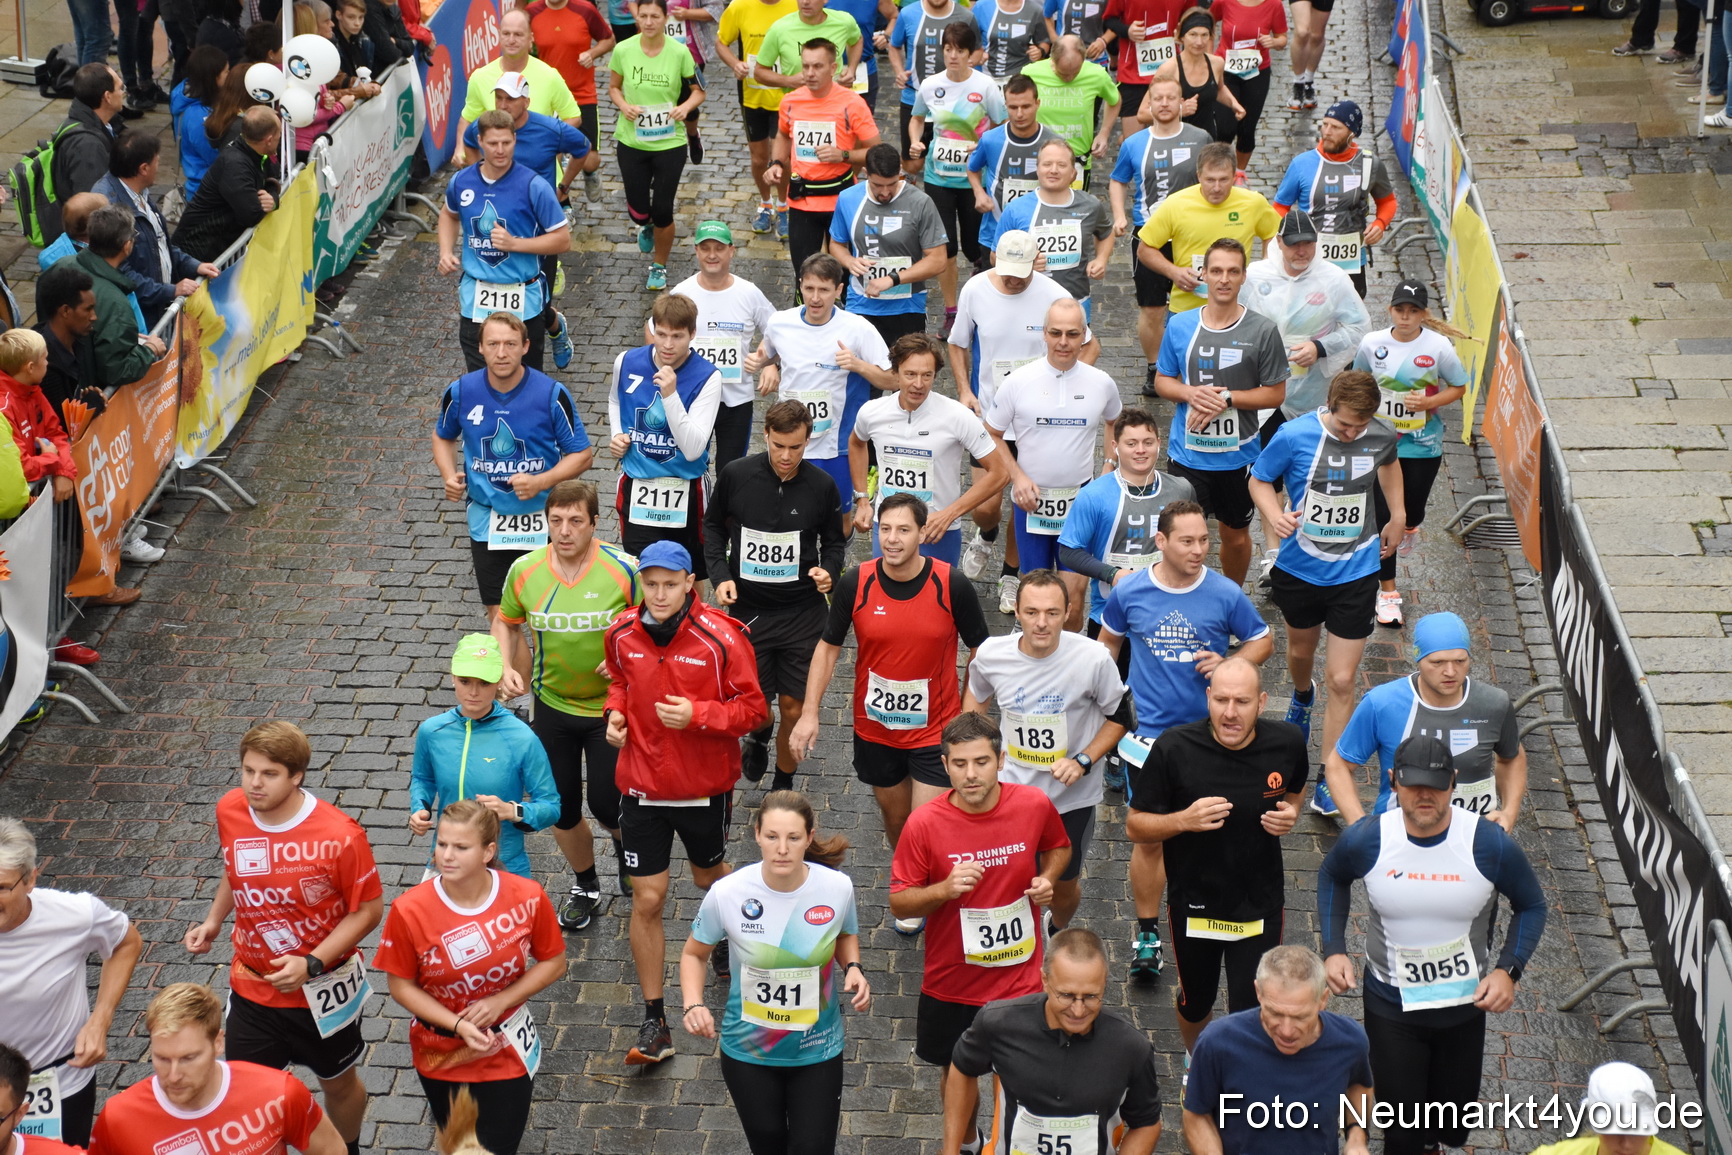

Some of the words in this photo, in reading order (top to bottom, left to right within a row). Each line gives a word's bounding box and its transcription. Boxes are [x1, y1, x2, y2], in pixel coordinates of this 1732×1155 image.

[464, 10, 499, 74] Hervis
[1140, 45, 1173, 63] 2018
[1229, 57, 1259, 71] 2373
[426, 64, 451, 132] Hervis
[1040, 87, 1083, 96] NOVINA
[1040, 98, 1083, 108] HOTELS
[637, 112, 670, 127] 2147
[797, 131, 832, 147] 2474
[937, 147, 970, 163] 2467
[460, 188, 475, 207] 9
[1036, 235, 1077, 253] 2252
[1321, 243, 1358, 259] 3039
[1047, 256, 1068, 264] Daniel
[479, 289, 520, 310] 2118
[625, 373, 644, 394] 7
[466, 404, 484, 426] 4
[1195, 438, 1228, 447] Christian
[474, 459, 544, 474] FIBALON
[884, 467, 927, 489] 2631
[637, 486, 684, 508] 2117
[645, 510, 671, 522] Jürgen
[1310, 504, 1360, 525] 2138
[495, 514, 544, 532] 2495
[501, 536, 536, 544] Christian
[1319, 528, 1346, 536] Tobias
[746, 541, 795, 564] 2884
[753, 566, 786, 576] Andreas
[529, 609, 614, 632] BOCK
[870, 687, 923, 712] 2882
[878, 713, 911, 724] Thomas
[1014, 726, 1055, 750] 183
[1017, 750, 1055, 764] Bernhard
[236, 841, 267, 850] raumbox
[976, 842, 1026, 860] RUNNERS
[624, 850, 639, 868] 53
[977, 856, 1009, 868] POINT
[275, 863, 315, 875] schenken
[1408, 872, 1466, 882] KLEBL
[808, 910, 832, 920] Hervis
[444, 924, 478, 944] raumbox
[741, 922, 765, 930] PARTL
[978, 916, 1024, 950] 340
[1206, 919, 1244, 934] Thomas
[983, 947, 1024, 963] Matthias
[1404, 951, 1470, 984] 3055
[756, 981, 802, 1007] 341
[767, 1010, 791, 1022] Nora
[157, 1132, 198, 1154] raumbox
[1037, 1132, 1072, 1155] 55
